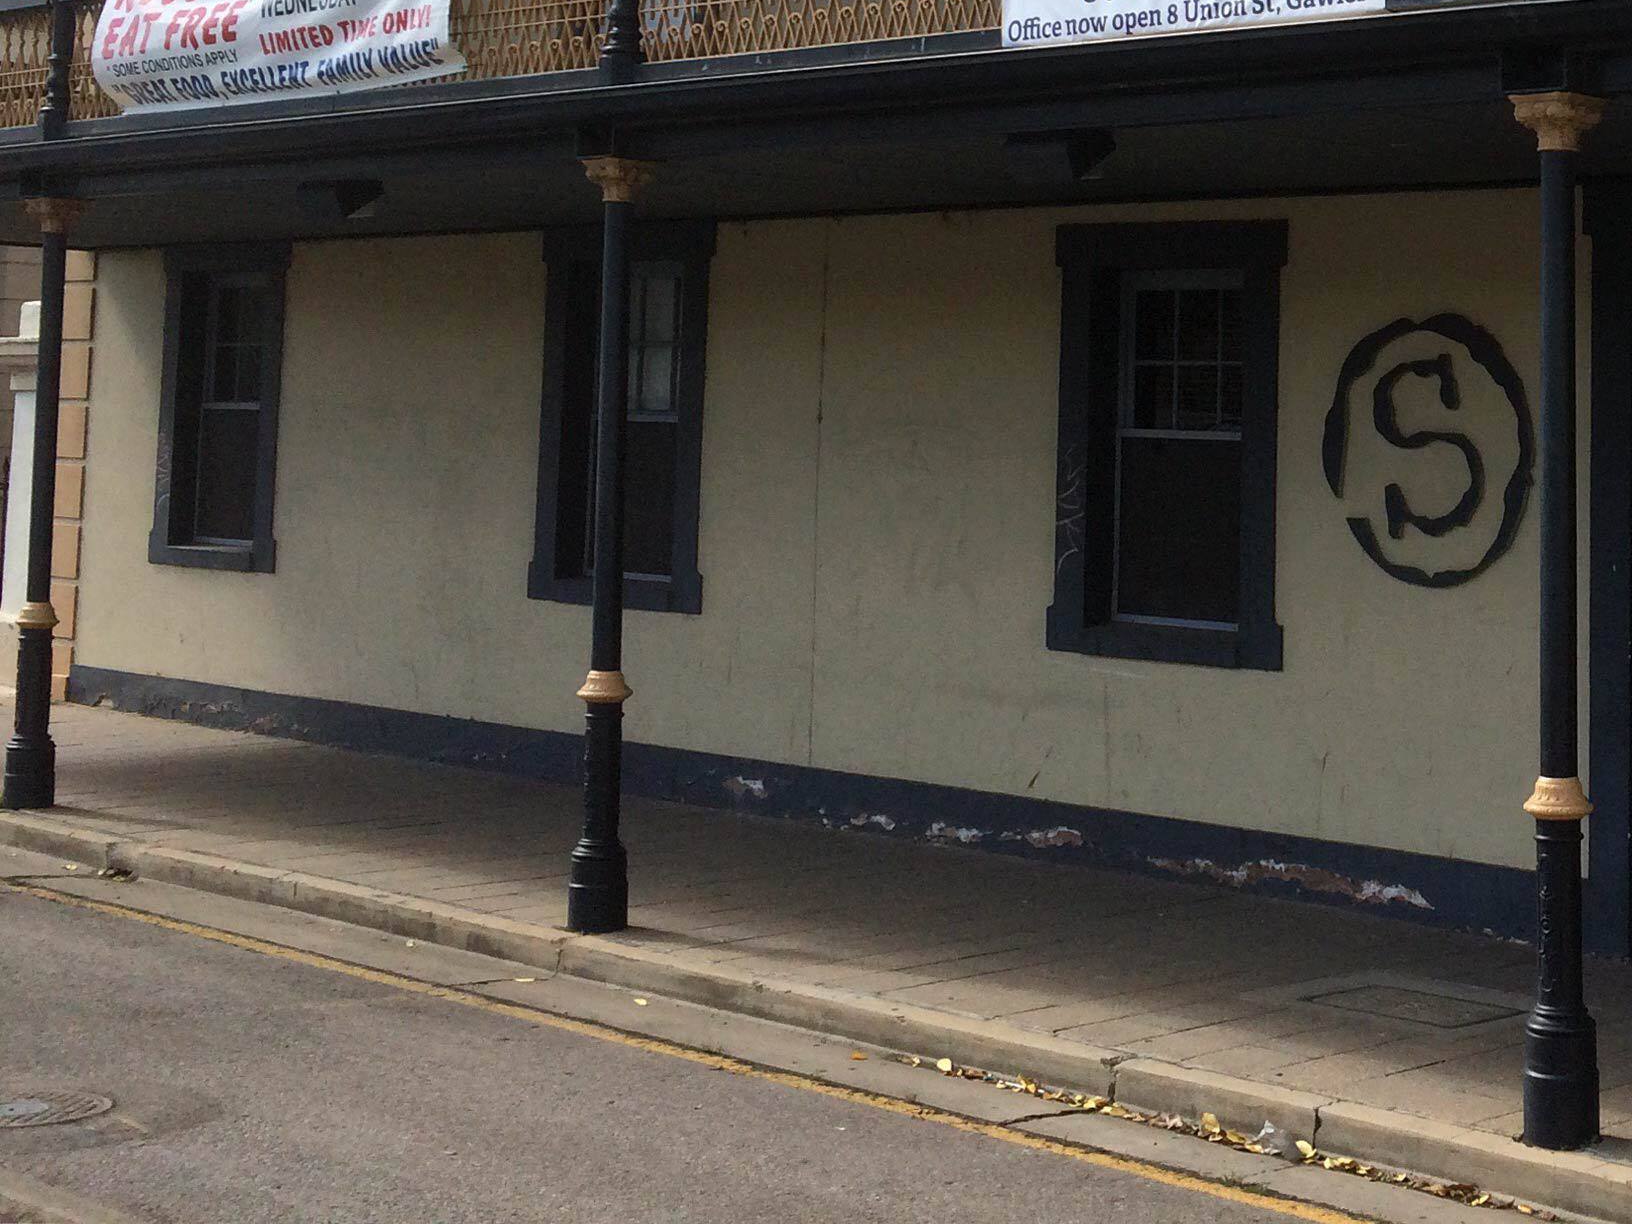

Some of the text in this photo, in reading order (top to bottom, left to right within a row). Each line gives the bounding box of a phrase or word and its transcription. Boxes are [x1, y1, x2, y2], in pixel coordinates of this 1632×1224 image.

[102, 13, 162, 60] EAT
[259, 5, 432, 55] LIMITED TIME ONLY!
[1008, 14, 1063, 42] Office
[1065, 13, 1108, 36] now
[1111, 9, 1163, 36] open
[1166, 4, 1179, 26] 8
[112, 49, 238, 78] SOME CONDITIONS APPLY
[223, 61, 310, 95] EXCELLENT
[317, 52, 377, 85] FAMILY
